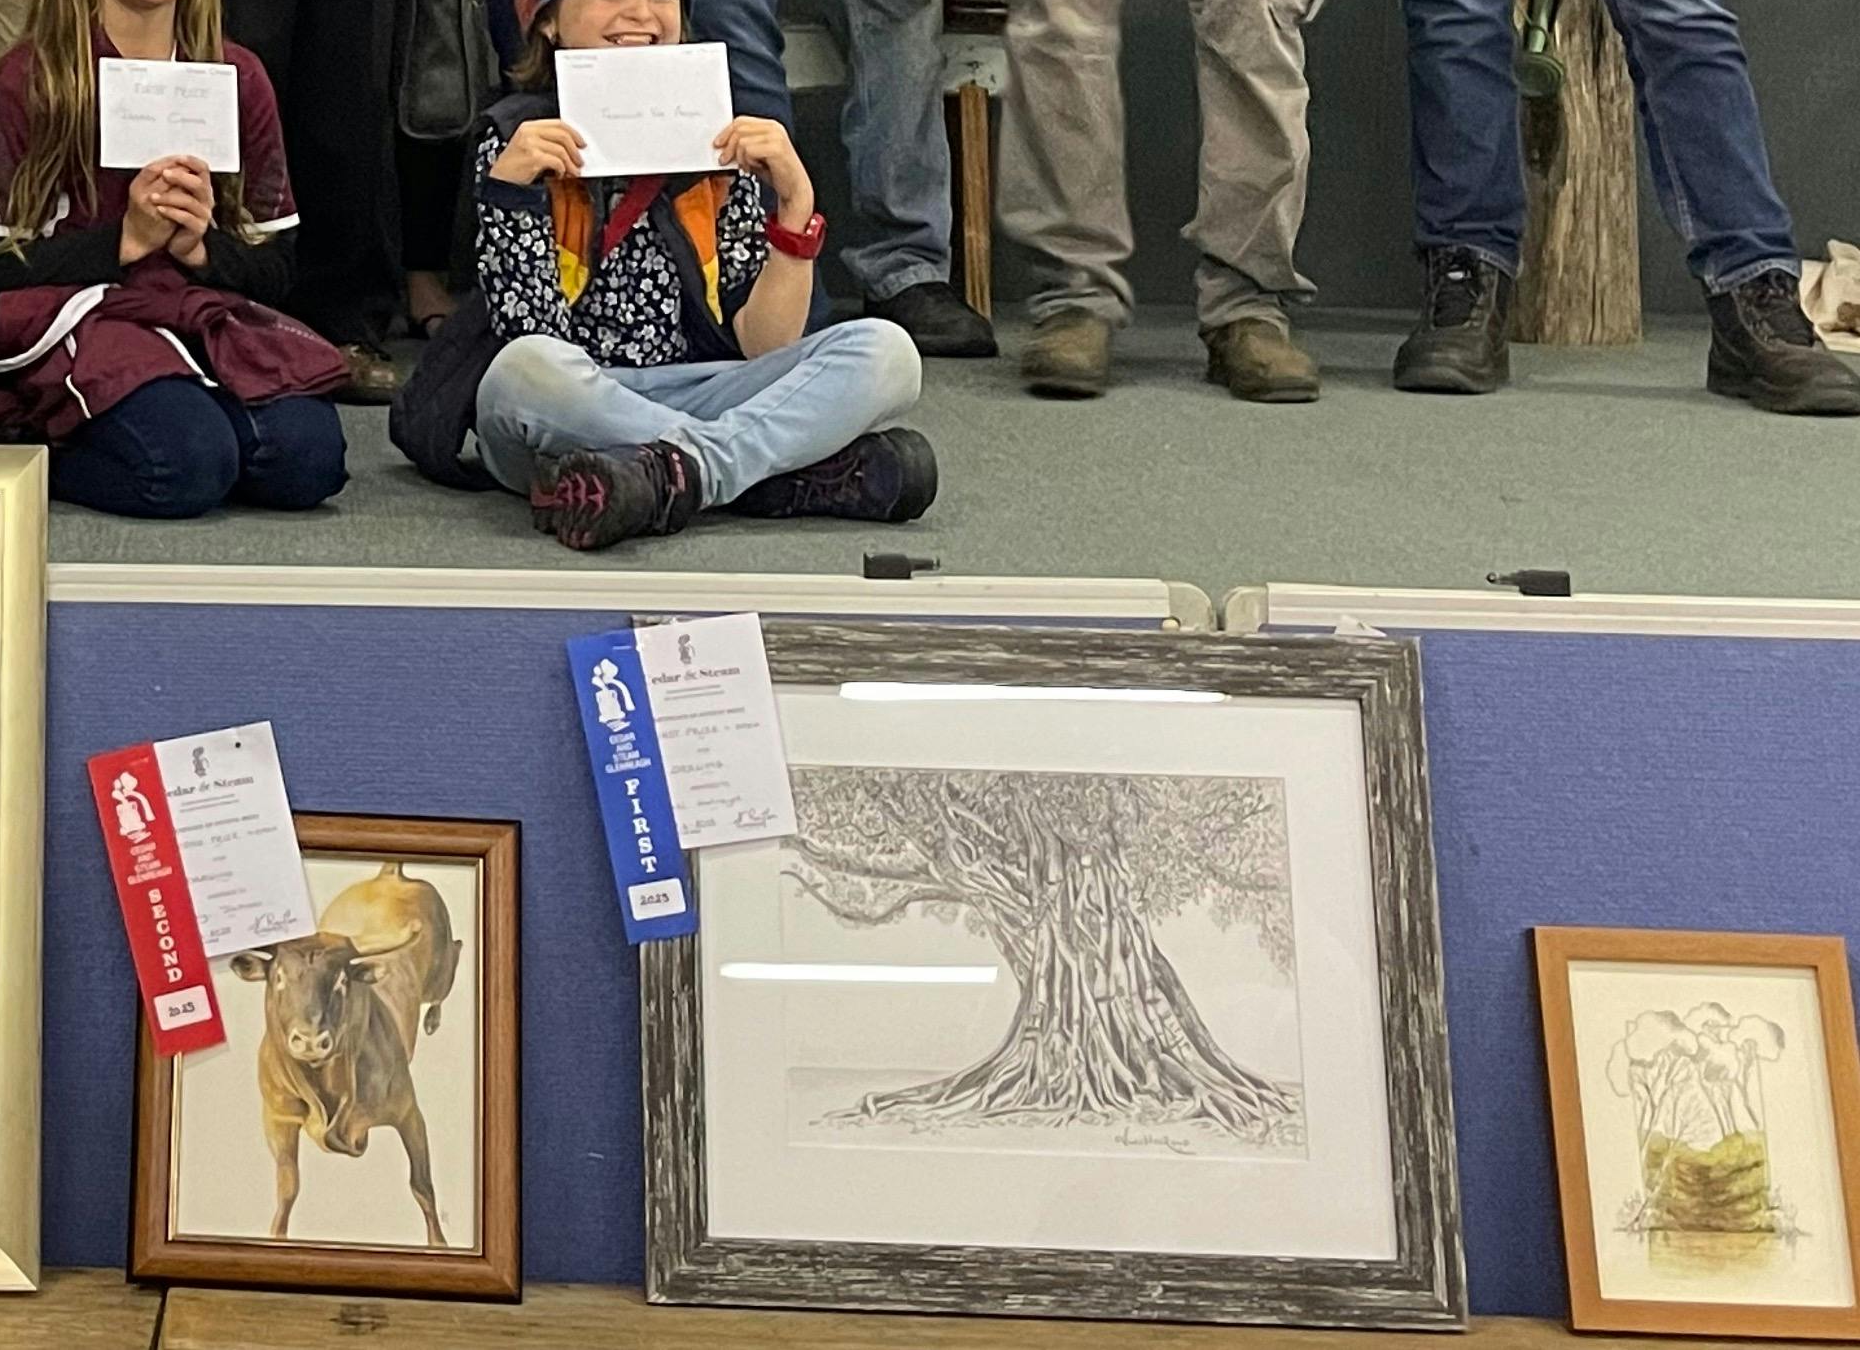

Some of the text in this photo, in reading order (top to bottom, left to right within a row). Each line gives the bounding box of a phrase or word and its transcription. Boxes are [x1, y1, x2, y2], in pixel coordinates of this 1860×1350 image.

[651, 672, 681, 685] edar
[167, 786, 196, 797] edar
[625, 779, 657, 873] FIRST
[148, 889, 182, 983] SECOND
